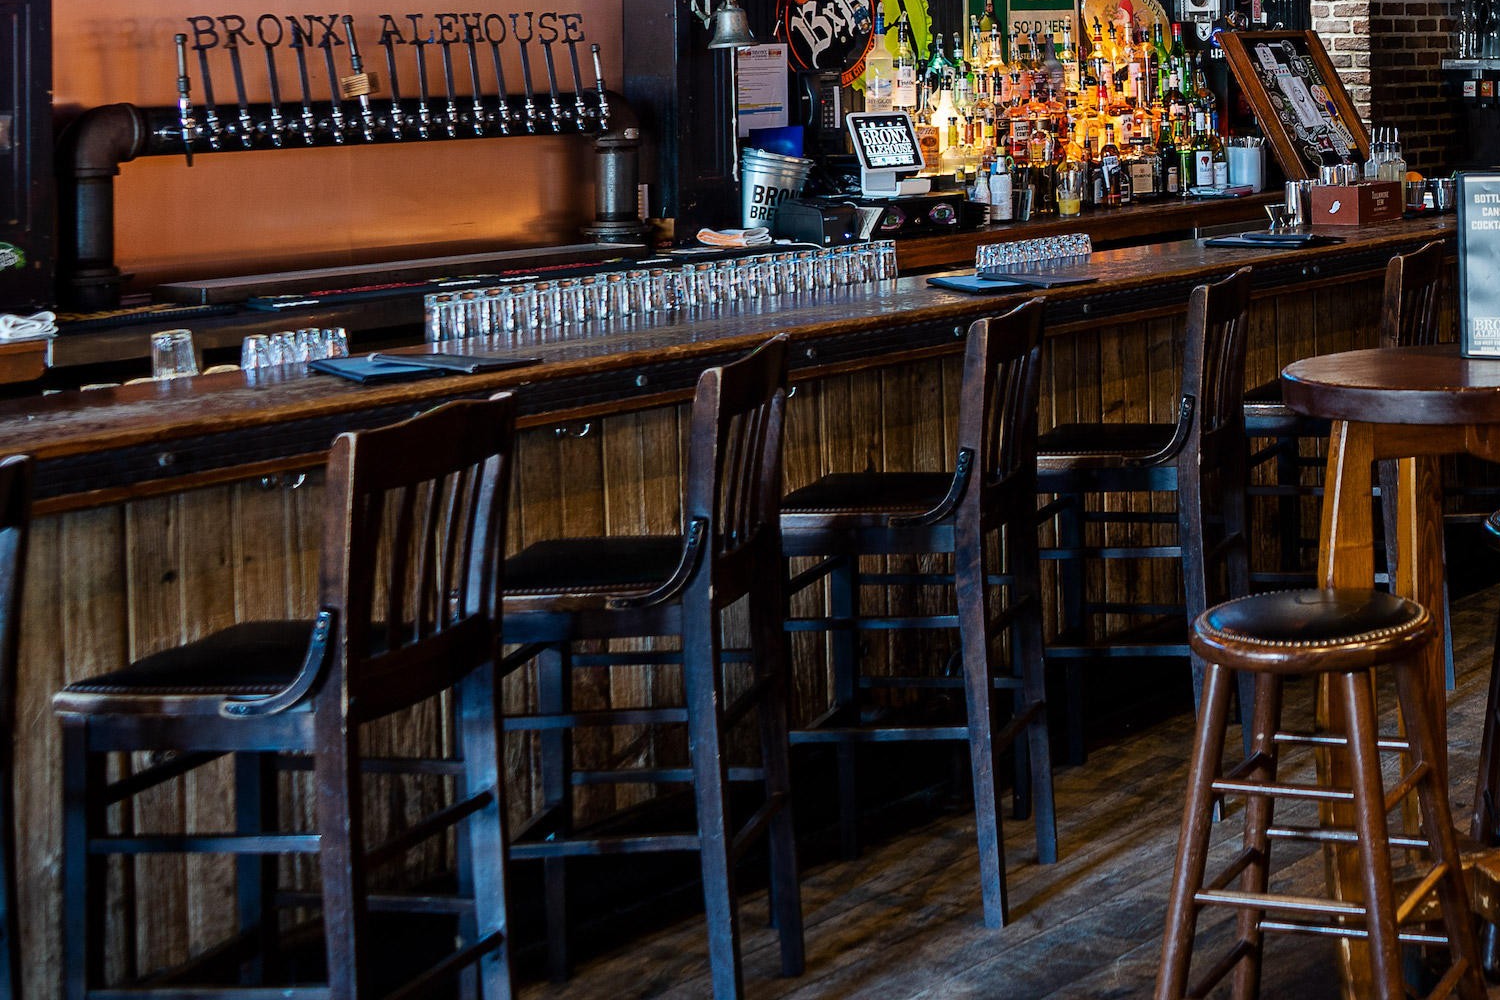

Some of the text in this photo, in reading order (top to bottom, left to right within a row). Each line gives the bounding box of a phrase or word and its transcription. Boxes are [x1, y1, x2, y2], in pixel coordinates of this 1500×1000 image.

[187, 12, 586, 50] BRONX ALEHOUSE
[1013, 19, 1072, 34] SOD HER
[859, 128, 911, 146] BRONX
[865, 143, 915, 157] ALEHOUSE
[752, 184, 800, 206] BRO
